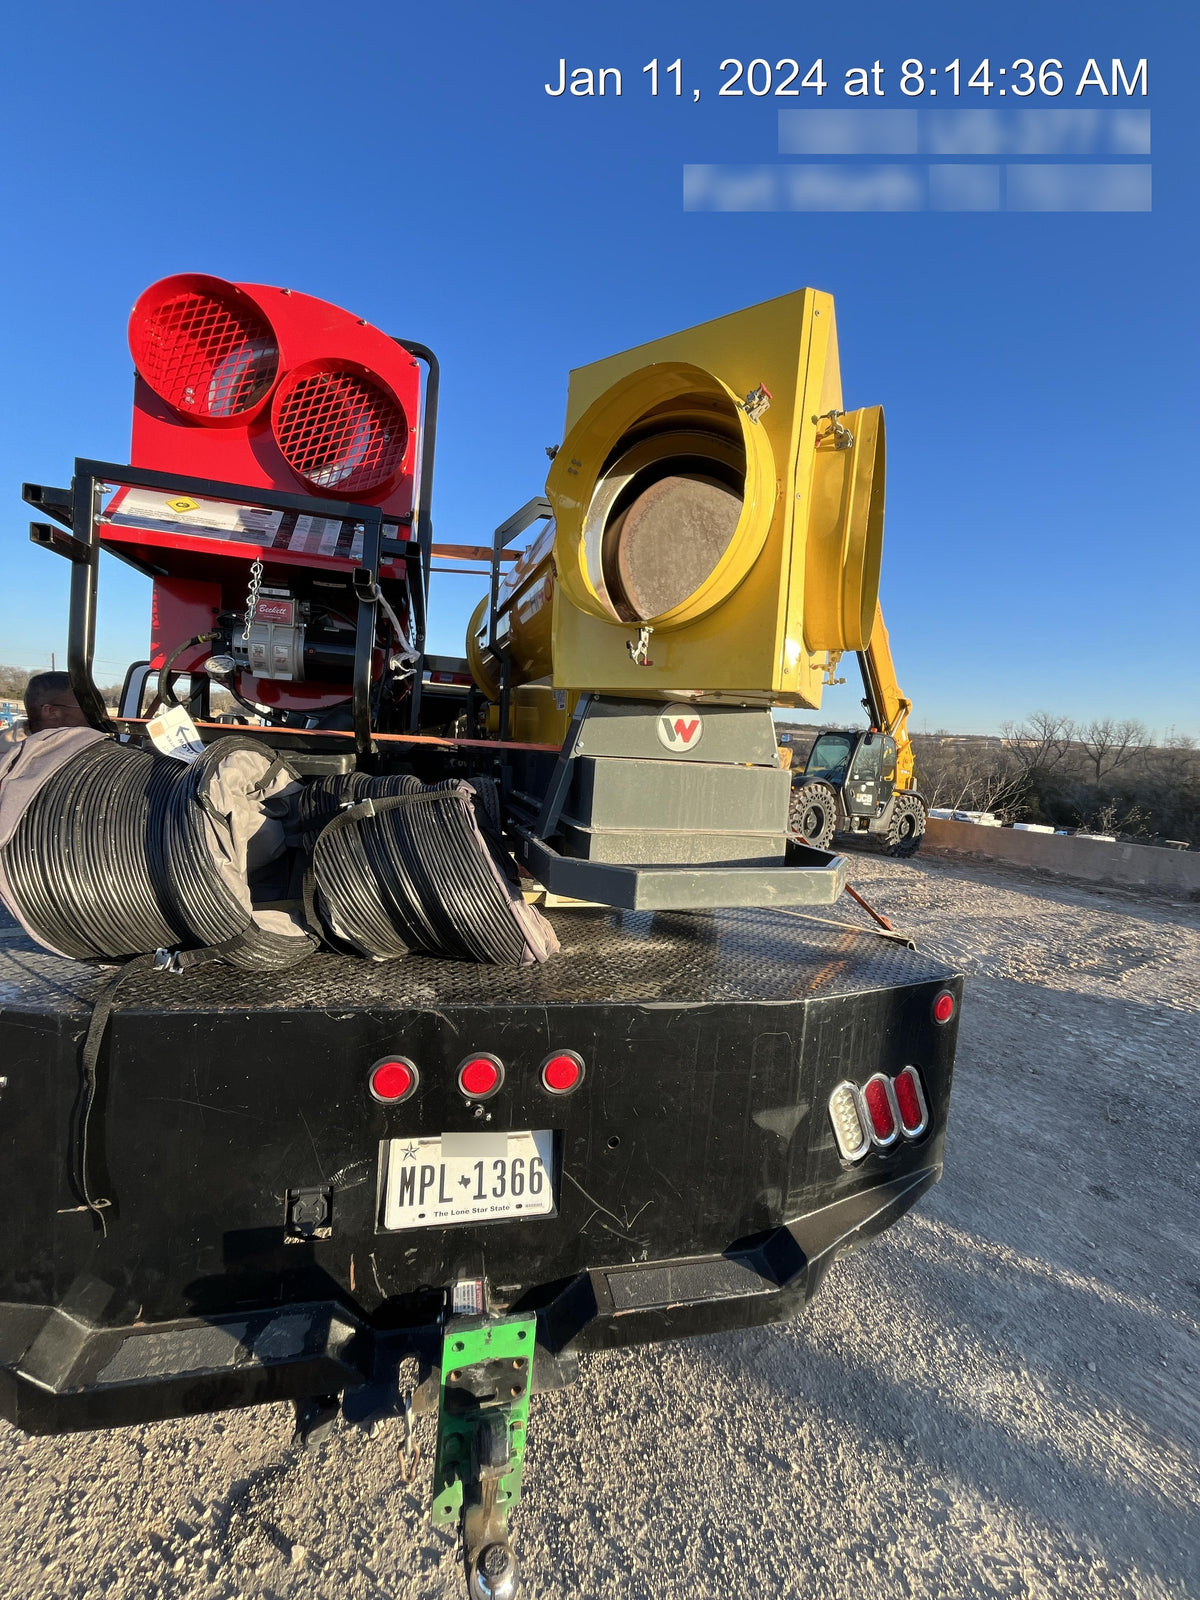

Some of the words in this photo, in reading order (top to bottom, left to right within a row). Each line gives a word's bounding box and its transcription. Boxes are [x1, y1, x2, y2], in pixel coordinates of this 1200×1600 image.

[259, 604, 287, 615] Beckett
[856, 793, 872, 802] JCB
[398, 1164, 453, 1207] MPL
[473, 1157, 543, 1200] 1366
[451, 1208, 470, 1216] Lone
